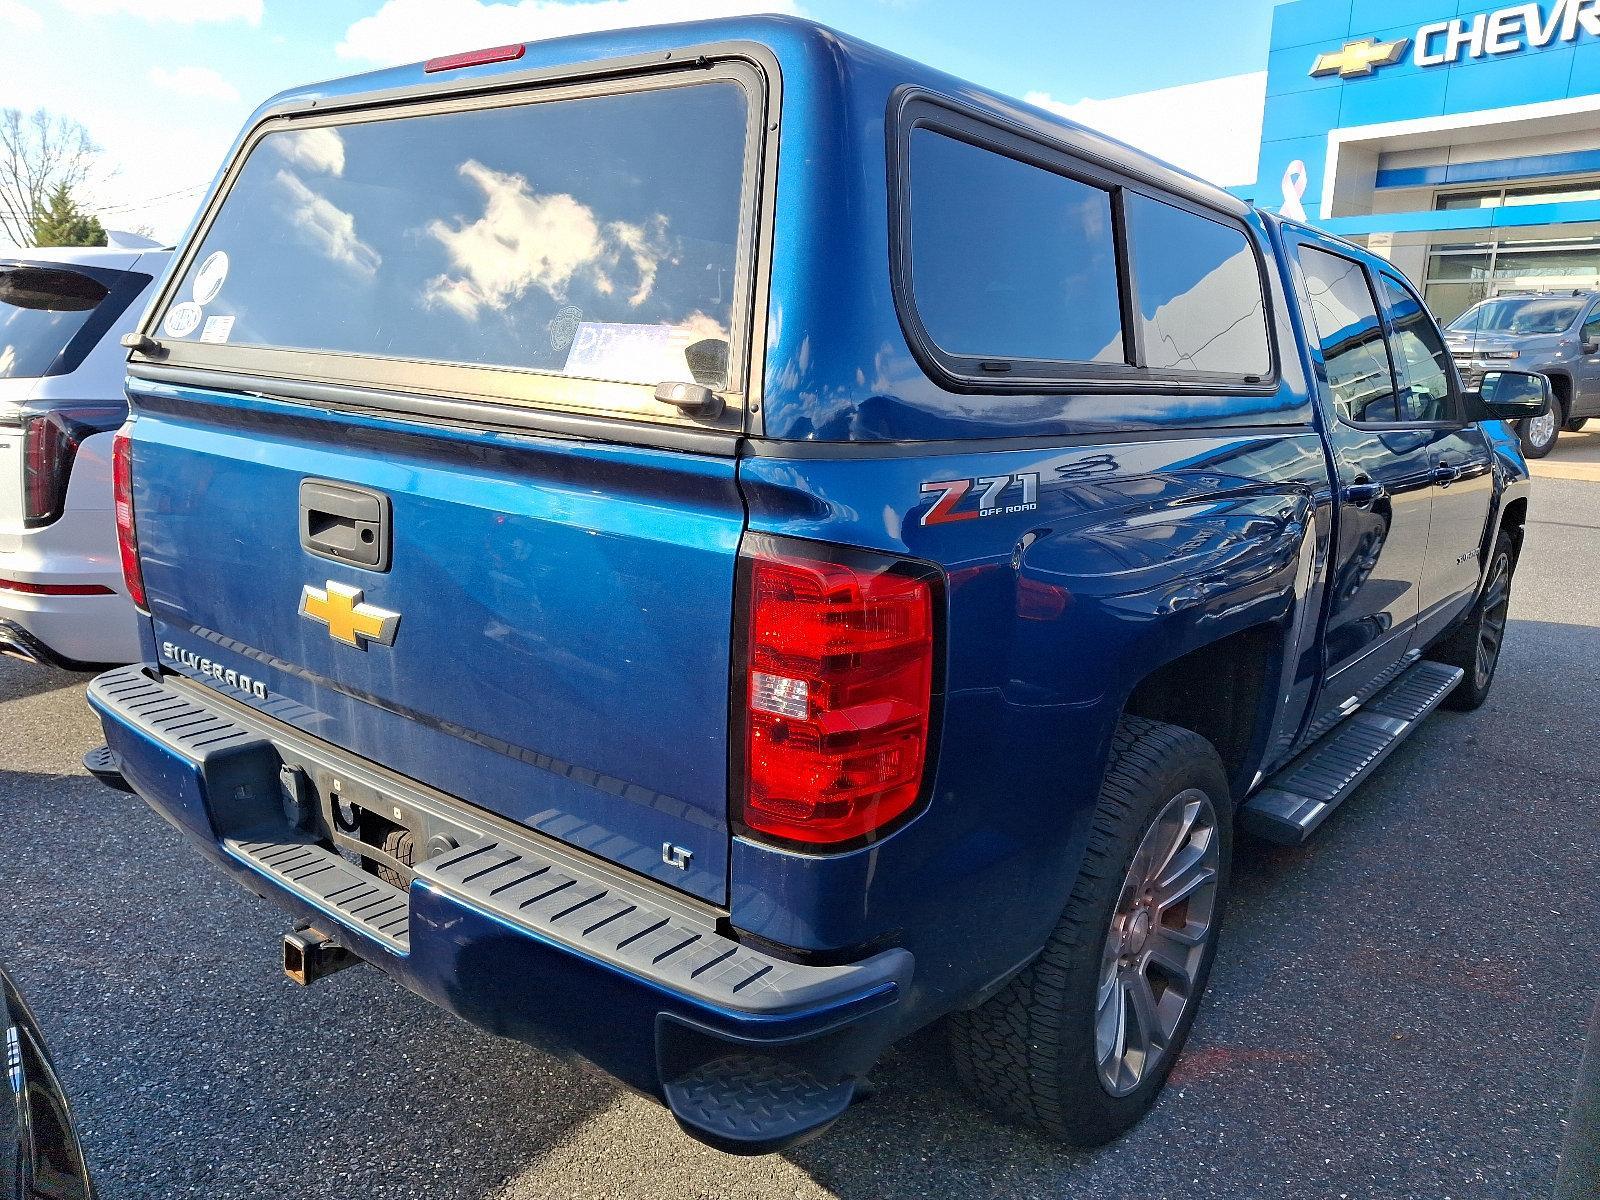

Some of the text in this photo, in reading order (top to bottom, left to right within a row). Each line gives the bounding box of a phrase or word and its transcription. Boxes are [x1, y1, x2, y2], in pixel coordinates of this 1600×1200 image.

[1414, 0, 1600, 67] CHEVR
[920, 472, 1039, 526] Z71
[979, 503, 1037, 518] OFF ROAD
[163, 641, 268, 700] SILVERADO
[662, 841, 694, 871] LT
